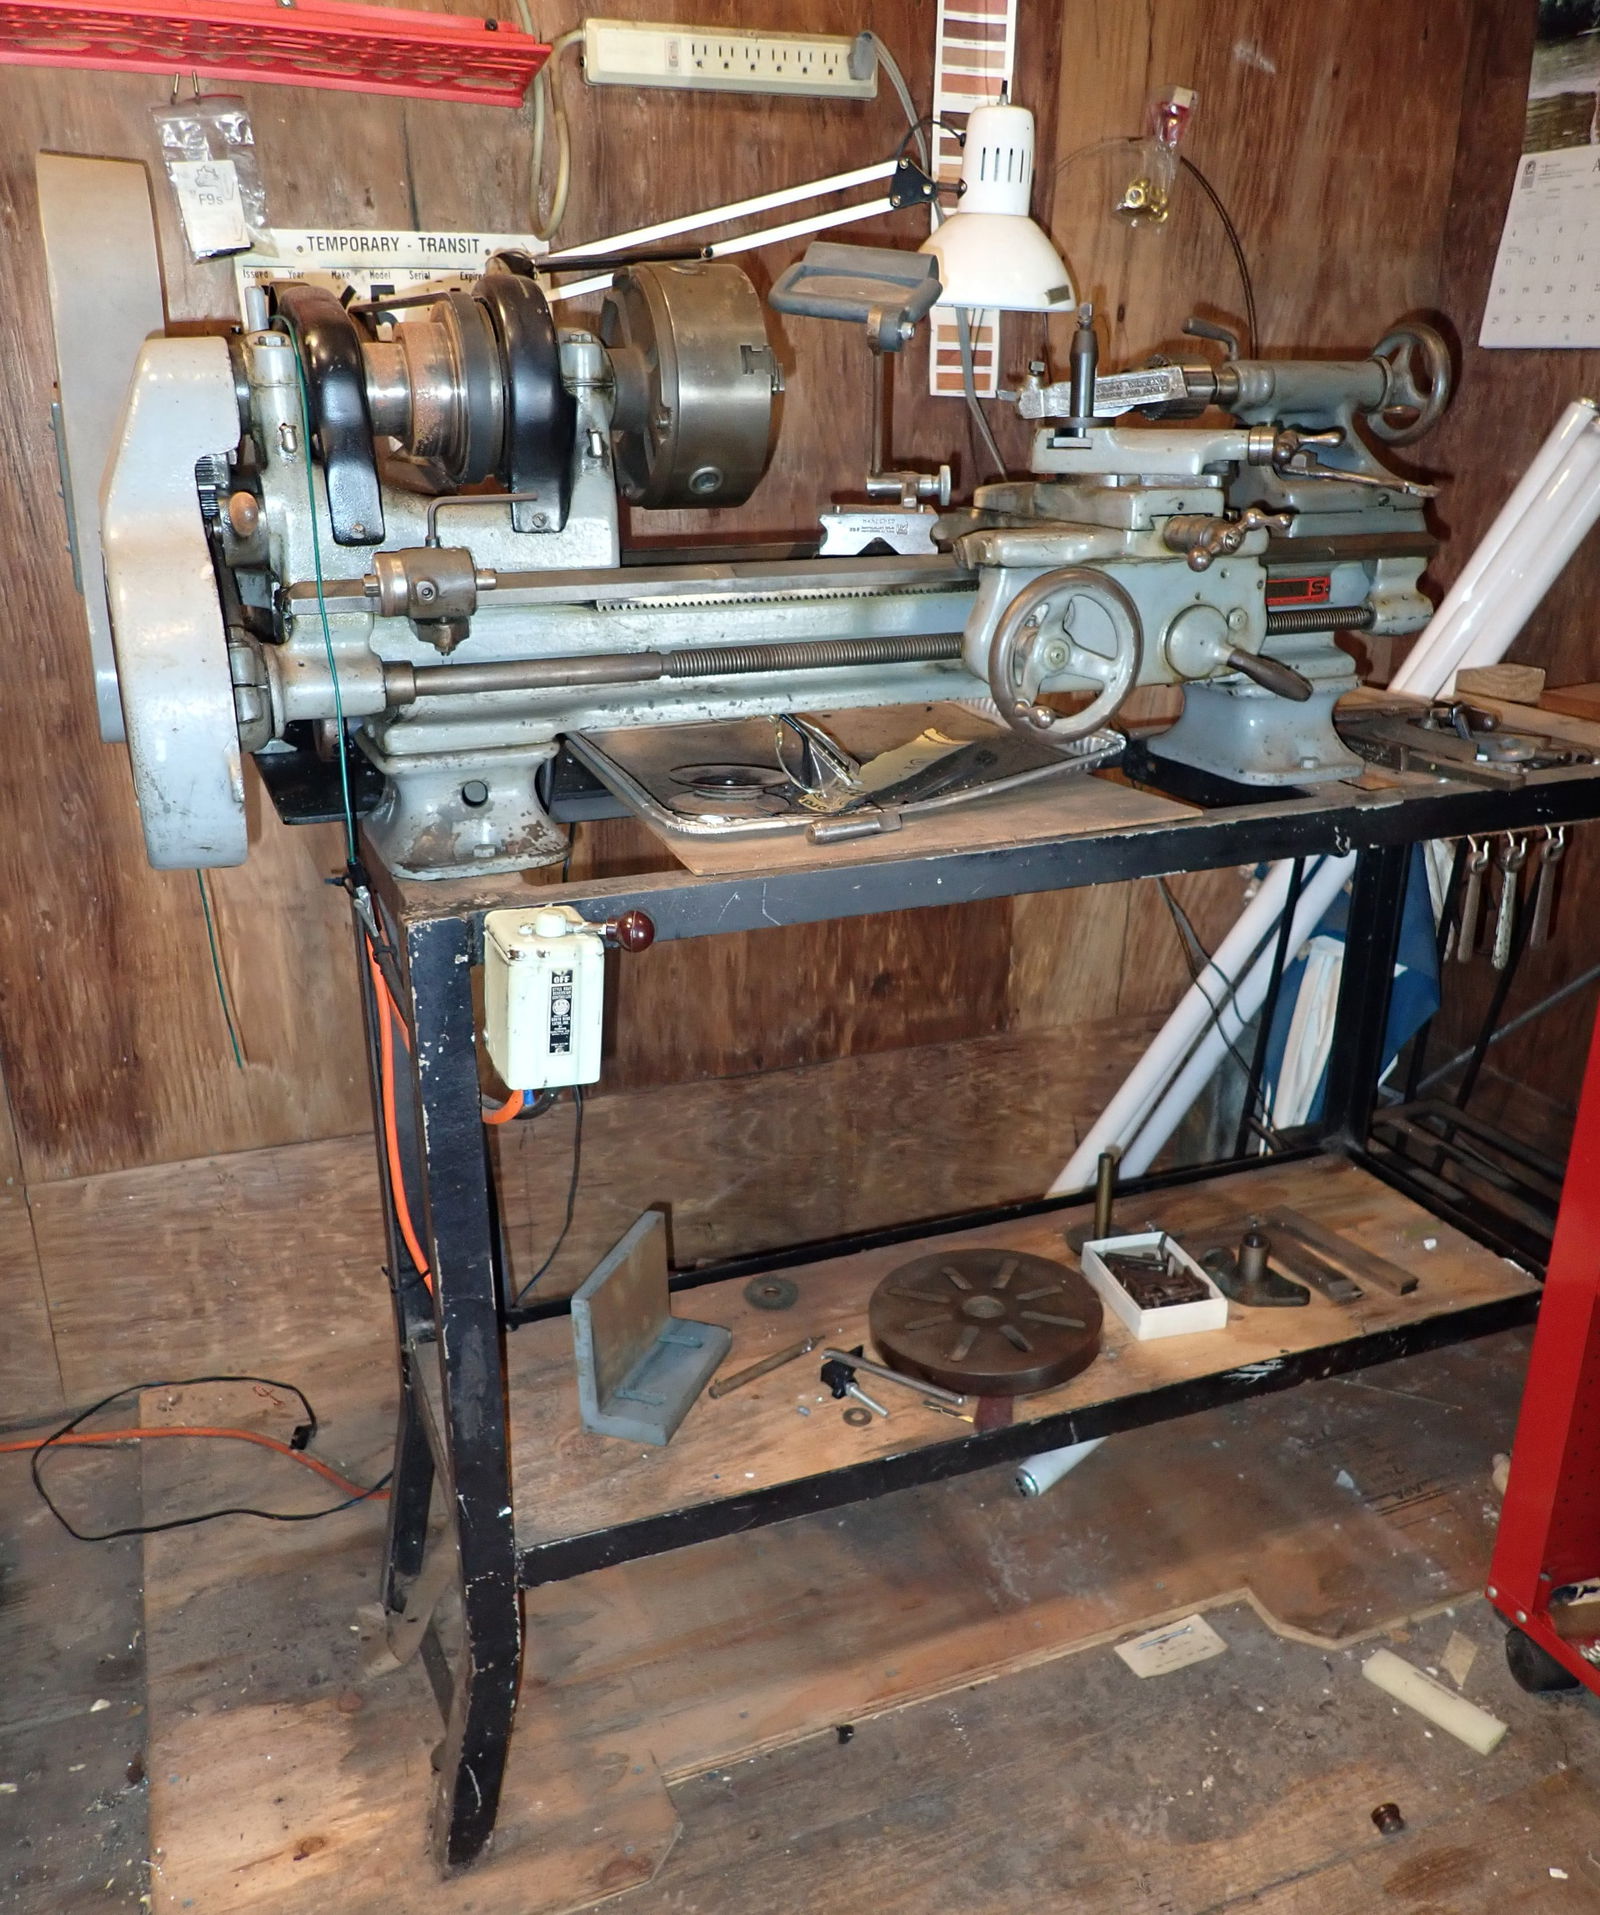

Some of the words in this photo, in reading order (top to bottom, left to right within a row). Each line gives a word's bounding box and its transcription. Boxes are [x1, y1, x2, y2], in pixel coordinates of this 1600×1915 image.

[306, 236, 400, 252] TEMPORARY
[418, 237, 480, 254] TRANSIT
[243, 269, 269, 280] Issued
[287, 270, 305, 280] Year
[331, 270, 351, 281] Make
[369, 270, 391, 280] Model
[409, 270, 431, 280] Serial
[553, 976, 570, 984] OFF
